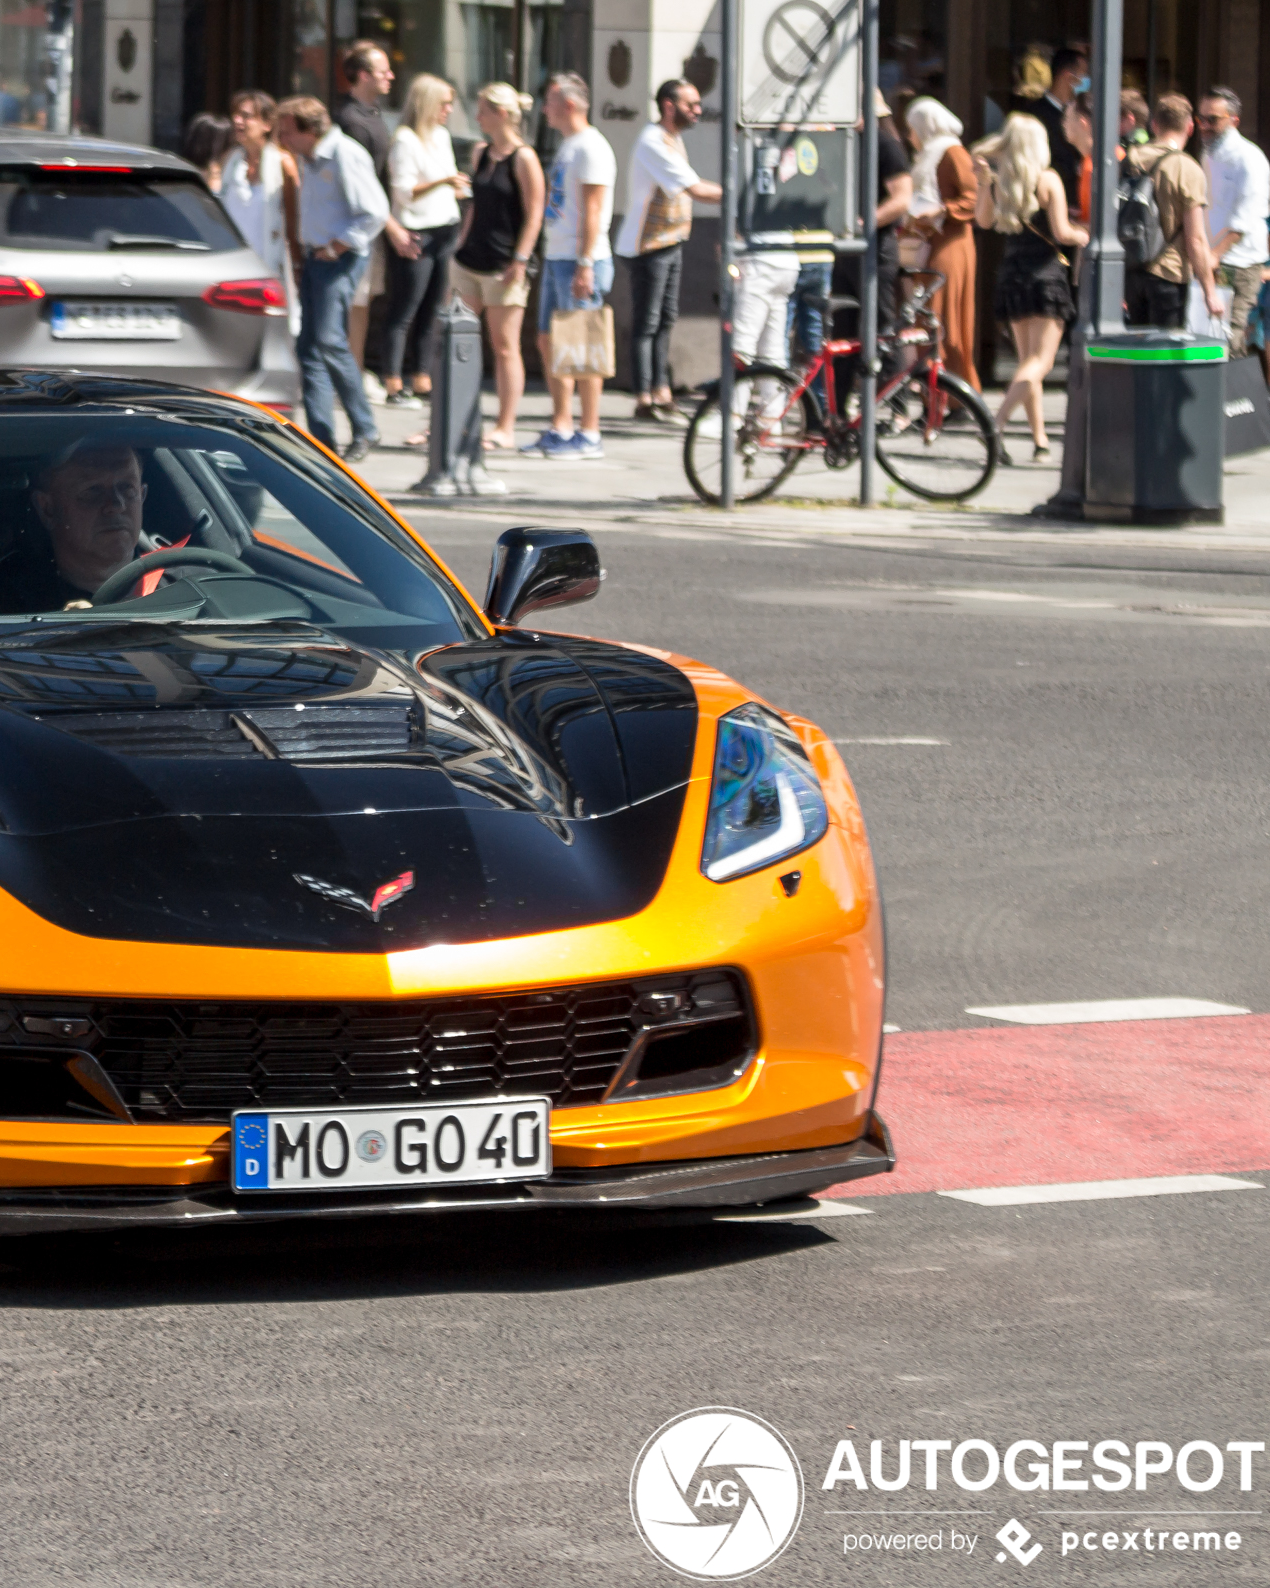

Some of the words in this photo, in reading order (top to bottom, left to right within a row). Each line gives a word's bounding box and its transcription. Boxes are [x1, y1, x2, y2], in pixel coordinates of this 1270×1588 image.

[274, 1119, 350, 1179] MO
[394, 1115, 466, 1174] GO
[478, 1111, 541, 1169] 40
[245, 1158, 260, 1176] D
